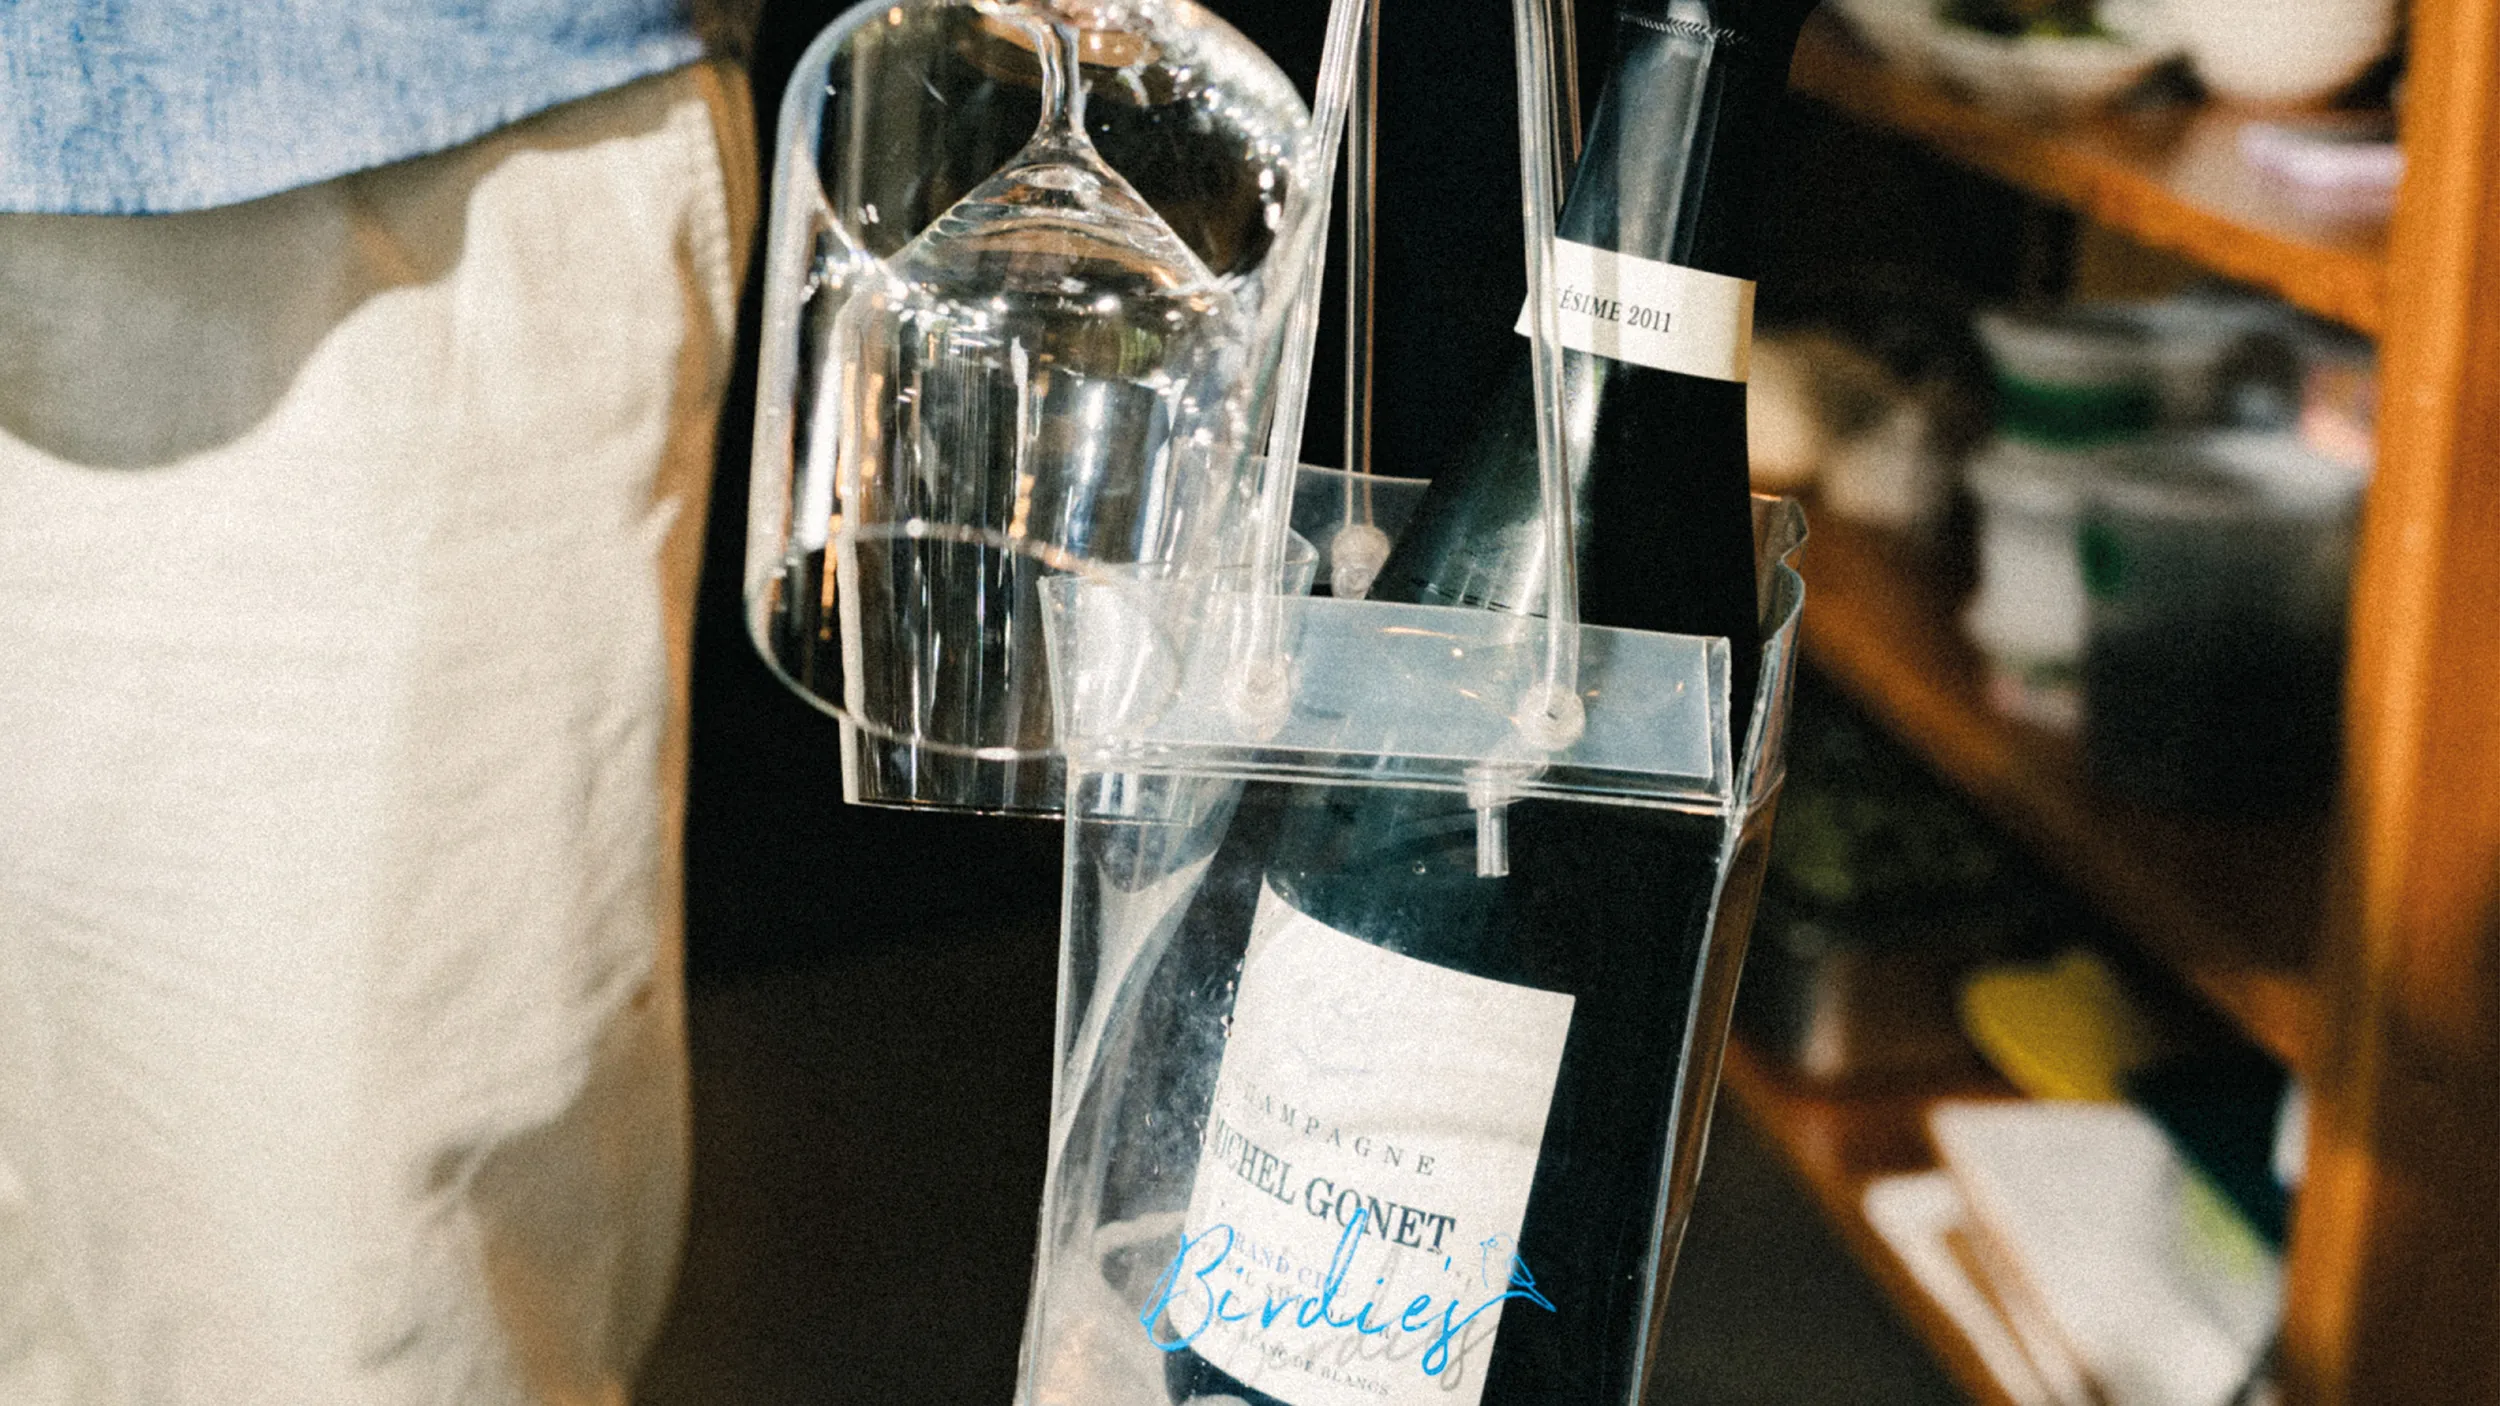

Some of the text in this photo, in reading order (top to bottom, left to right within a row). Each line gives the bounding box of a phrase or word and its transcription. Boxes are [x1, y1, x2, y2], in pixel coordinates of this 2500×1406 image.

[1558, 284, 1672, 334] ÉSIME 2011
[1304, 1176, 1457, 1255] GONET
